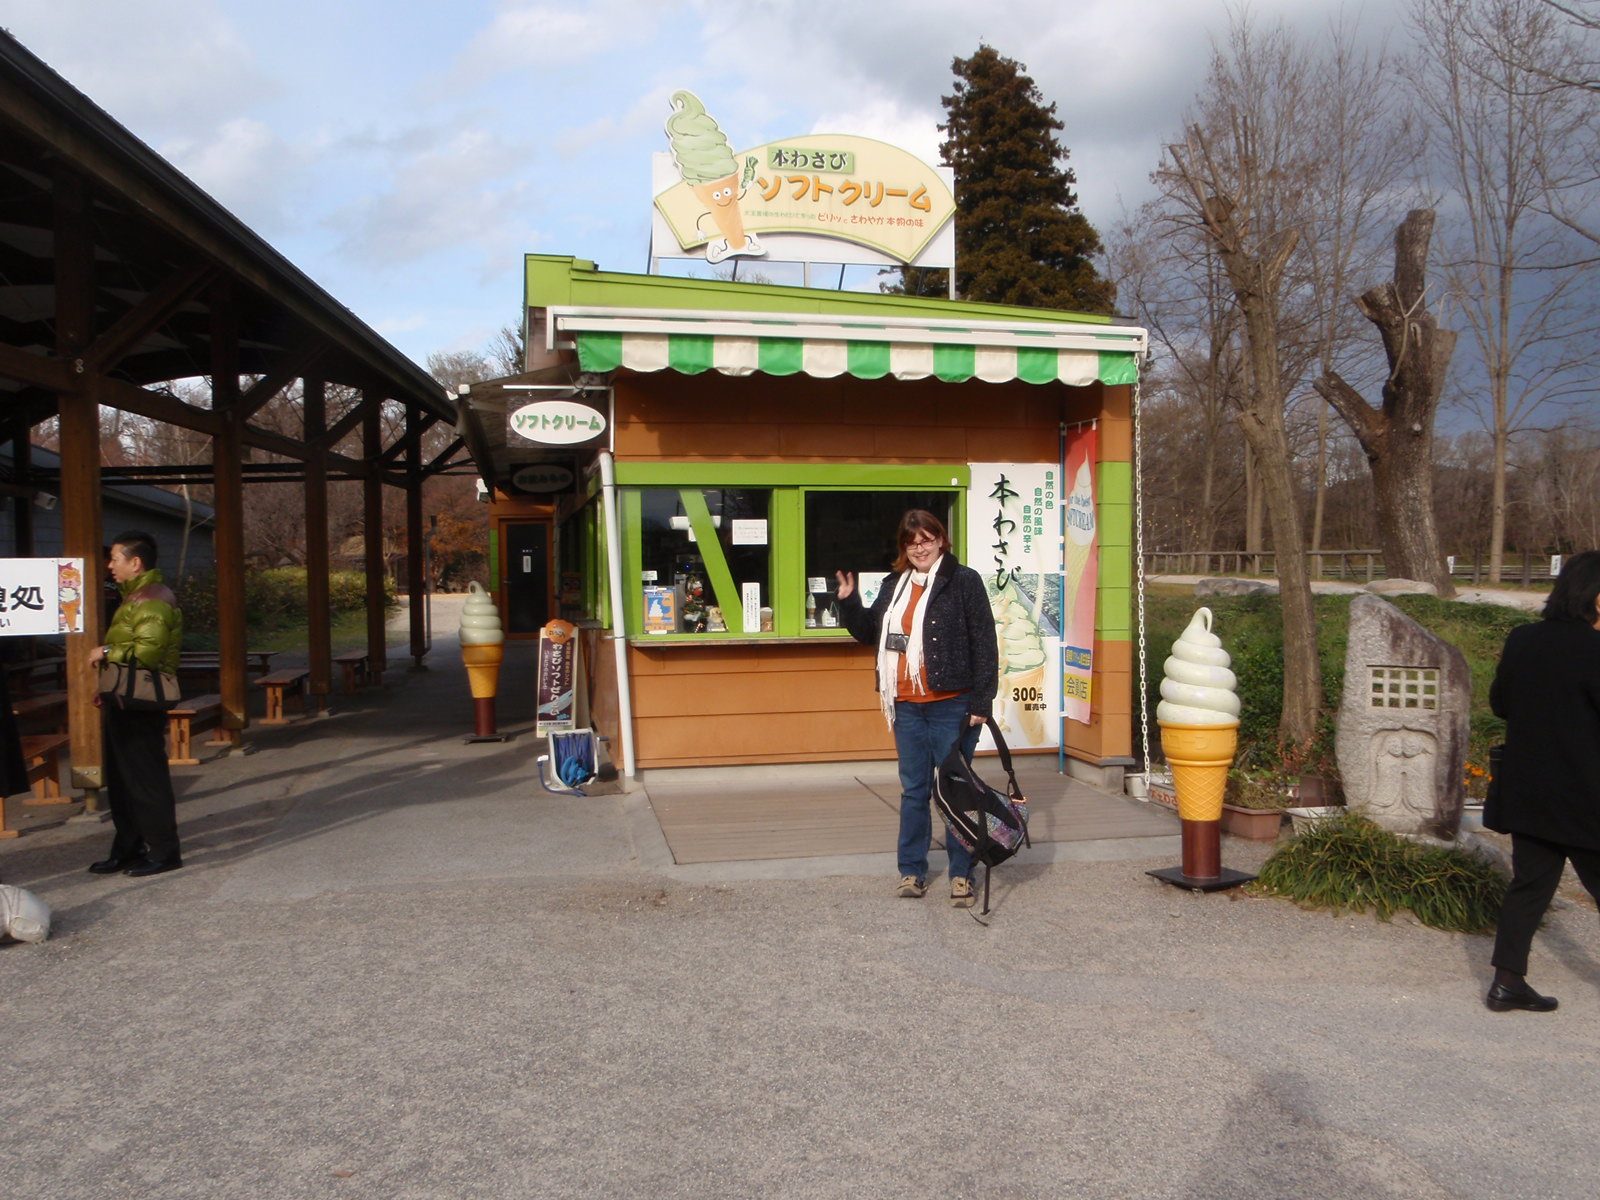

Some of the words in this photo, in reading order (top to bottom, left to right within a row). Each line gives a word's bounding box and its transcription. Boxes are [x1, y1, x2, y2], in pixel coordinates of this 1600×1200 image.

[772, 149, 848, 170] 本わさび
[757, 175, 932, 212] ソフトクリーム
[515, 414, 601, 431] ソフトクリーム
[1045, 471, 1054, 510] 自然の色
[1034, 487, 1043, 536] 自然の風味
[987, 473, 1024, 592] 本わさび
